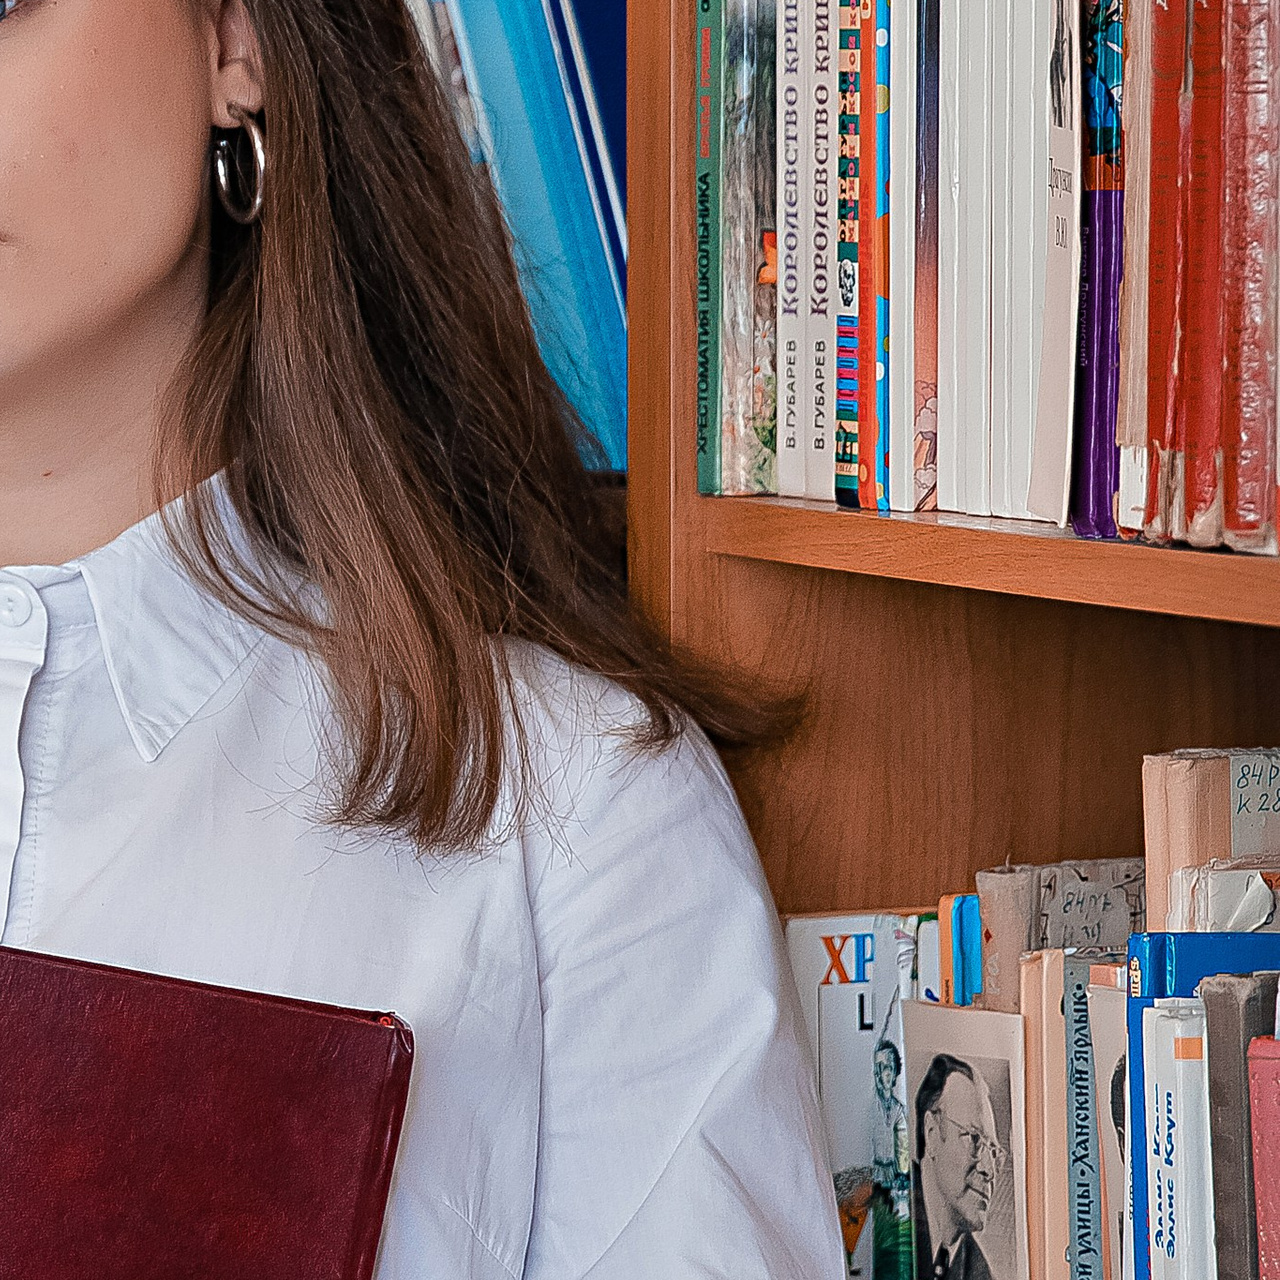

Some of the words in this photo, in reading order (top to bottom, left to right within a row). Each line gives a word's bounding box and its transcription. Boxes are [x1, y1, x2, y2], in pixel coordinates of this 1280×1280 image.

[697, 172, 710, 302] ШКОЛЬНИКА
[1164, 1091, 1176, 1167] Каут
[1076, 1182, 1098, 1255] улицы
